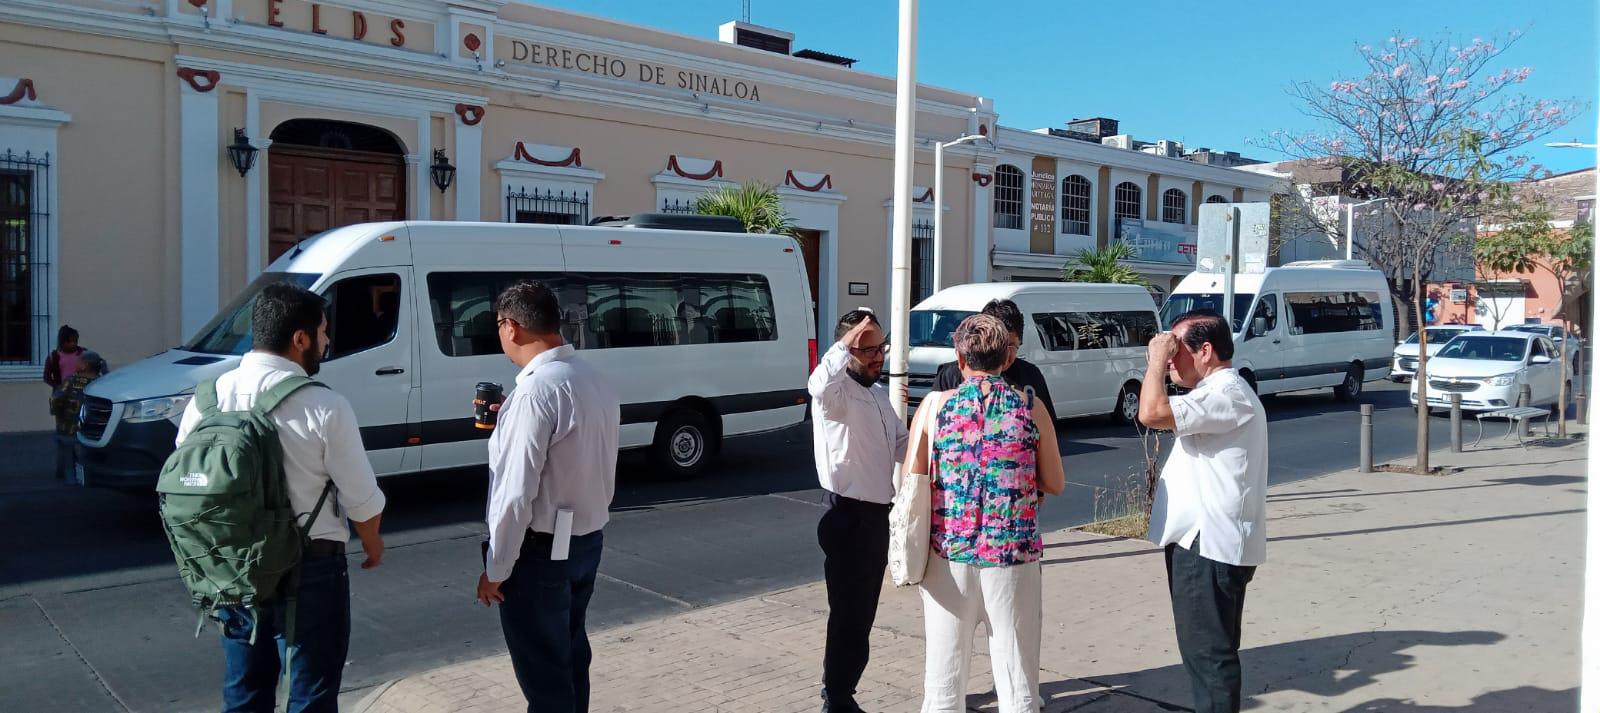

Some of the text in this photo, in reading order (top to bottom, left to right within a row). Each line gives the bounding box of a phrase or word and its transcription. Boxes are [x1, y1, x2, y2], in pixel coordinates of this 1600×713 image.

[511, 40, 762, 102] DERECHO DE SINALOA
